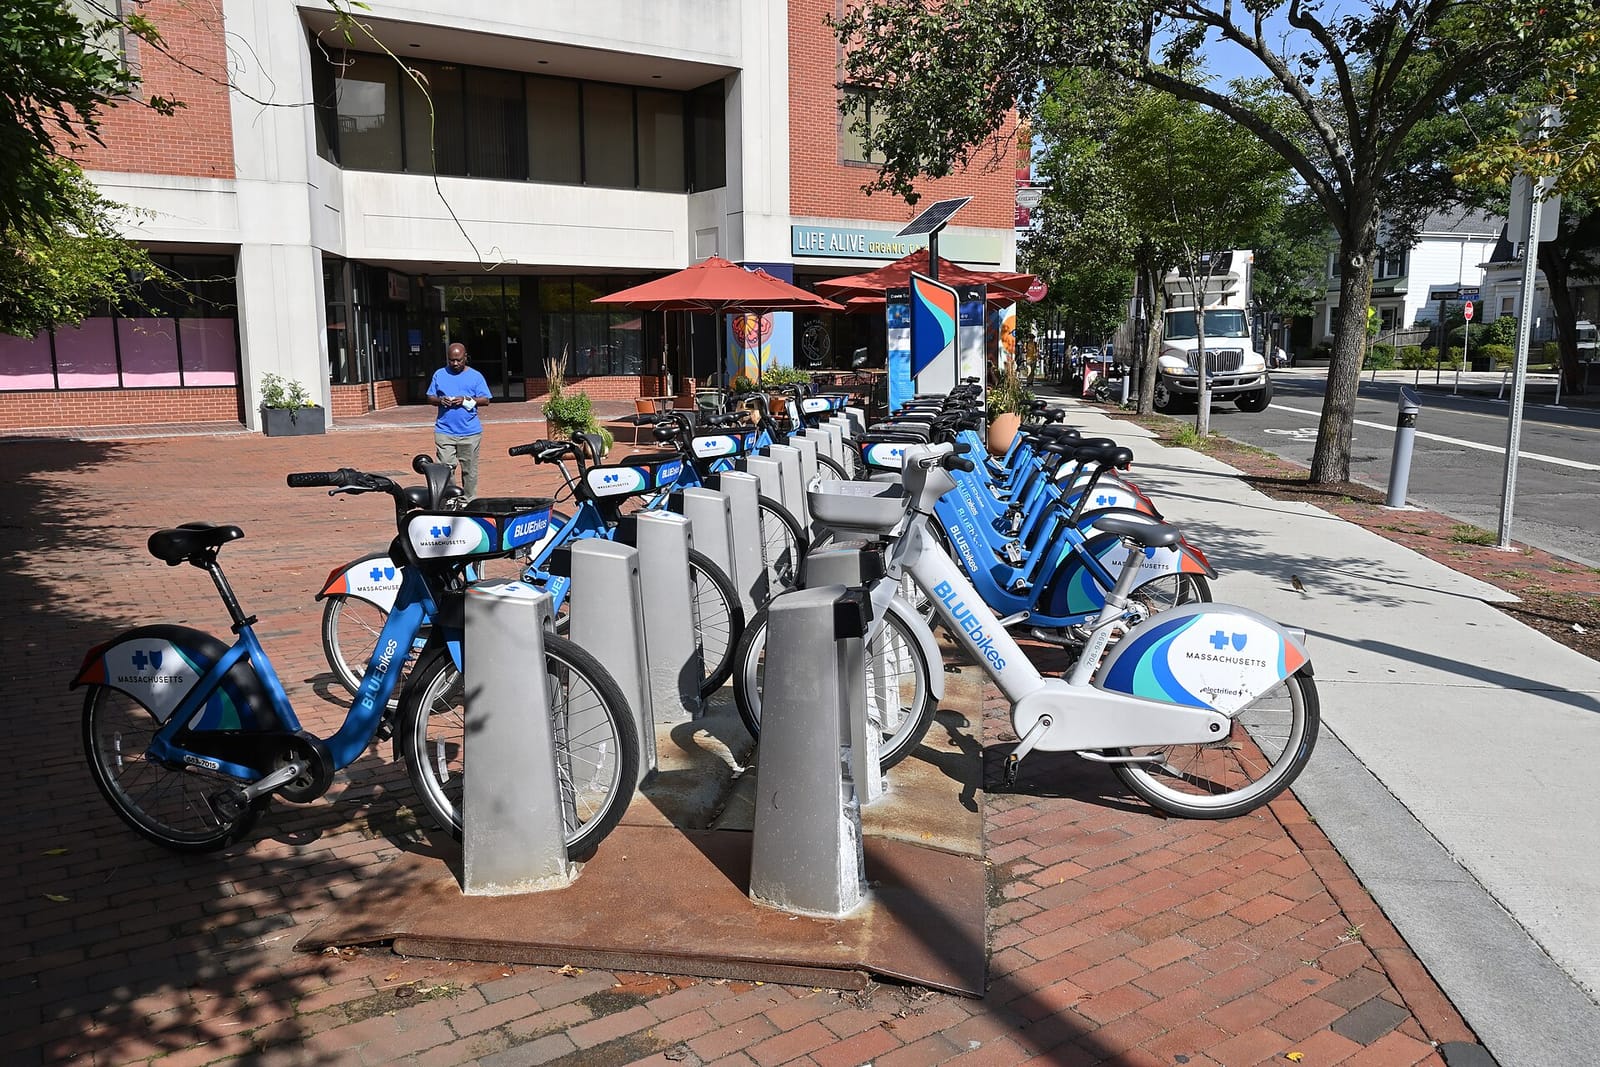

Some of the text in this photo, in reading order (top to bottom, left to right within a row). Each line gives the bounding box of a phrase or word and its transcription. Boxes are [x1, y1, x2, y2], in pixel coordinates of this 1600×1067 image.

[798, 231, 825, 251] LIFE
[828, 233, 865, 252] ALIVE
[868, 241, 905, 255] ORGANIC
[452, 286, 474, 302] 20
[514, 518, 548, 538] BLUEbikes
[419, 539, 467, 547] MASSACHUSETTS
[949, 524, 979, 573] BLUEbikes
[356, 584, 400, 593] MASSACHUSE
[933, 579, 1007, 671] BLUEbikes
[1185, 651, 1267, 668] MASSACHUSETTS
[117, 675, 184, 684] MASSACHUSETTS
[361, 638, 398, 712] BLUEbikes
[1202, 686, 1238, 696] electrified
